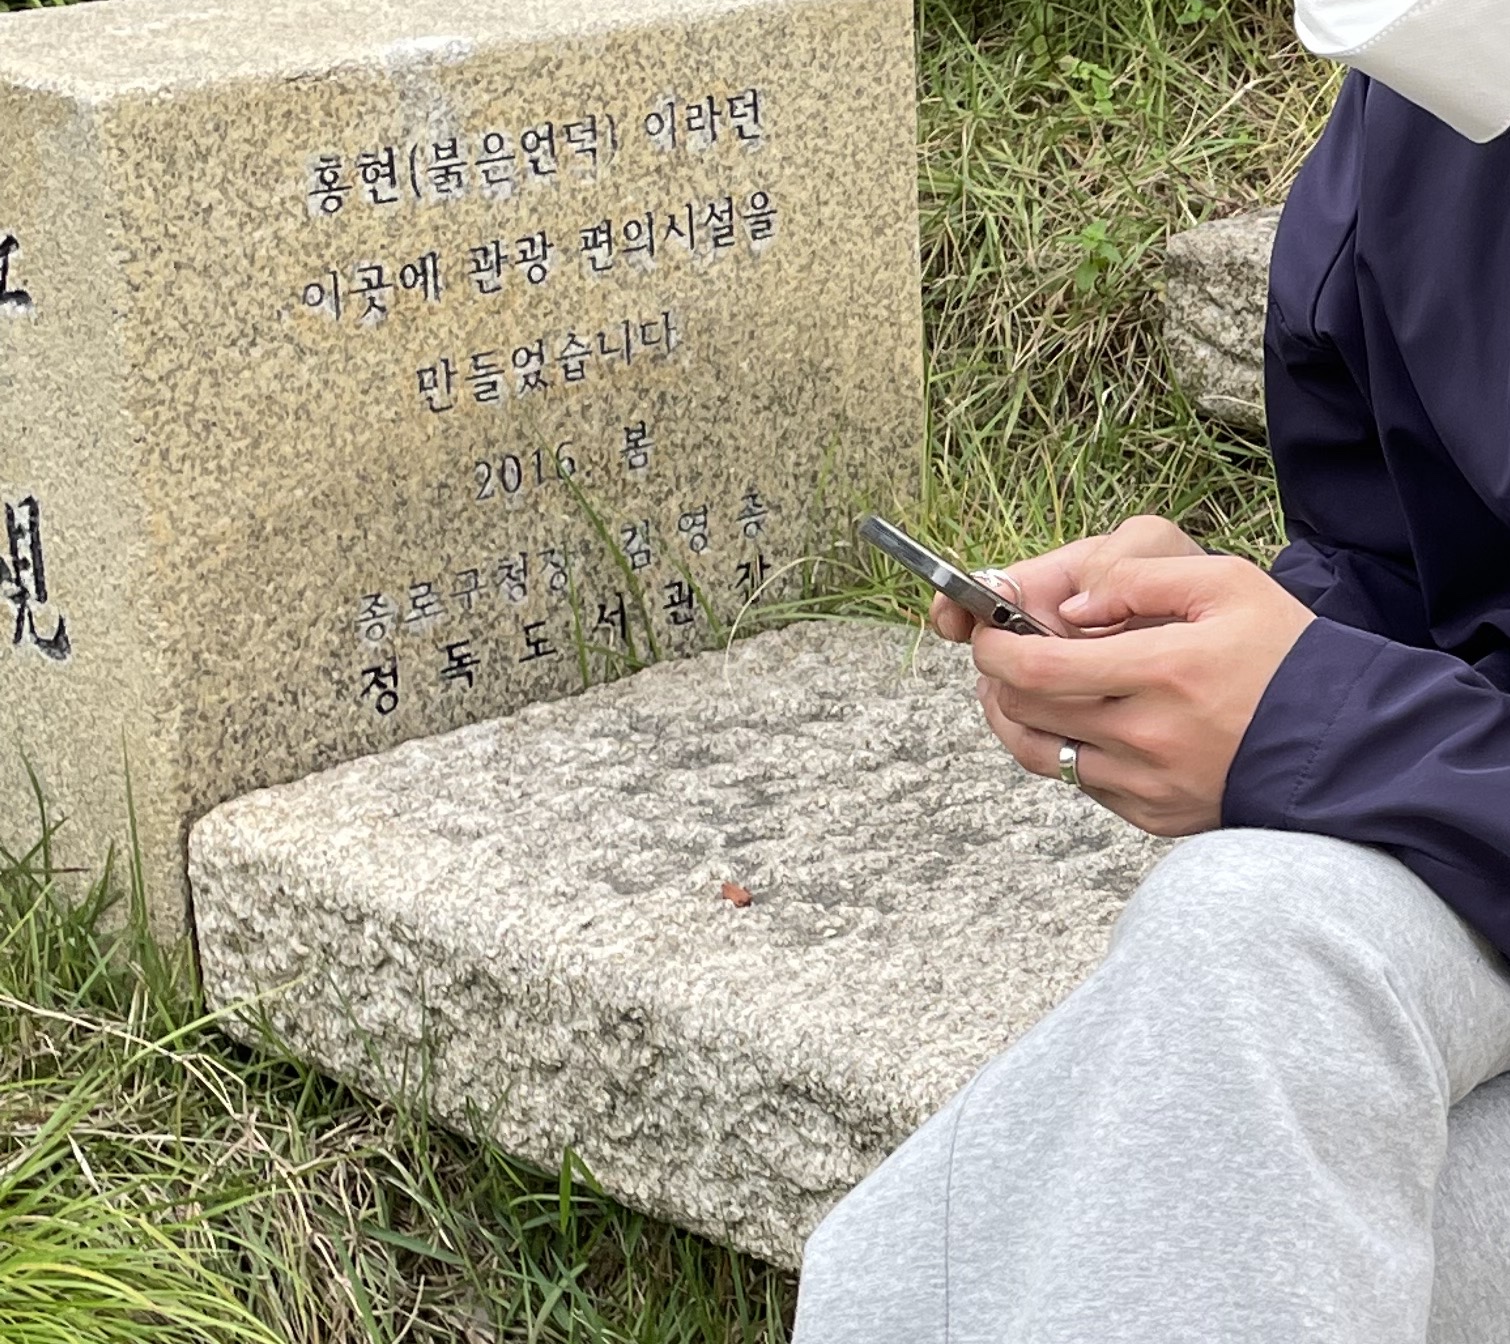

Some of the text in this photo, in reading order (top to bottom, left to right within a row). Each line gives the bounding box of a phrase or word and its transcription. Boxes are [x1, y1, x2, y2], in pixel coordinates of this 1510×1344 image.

[308, 88, 763, 215] 홍현(붉은언덕) 이라던
[302, 190, 778, 322] 이곳에 관광 편의시설을
[416, 311, 677, 414] 만들었습니다
[619, 420, 654, 471] 봄
[358, 546, 572, 642] 종로구청장
